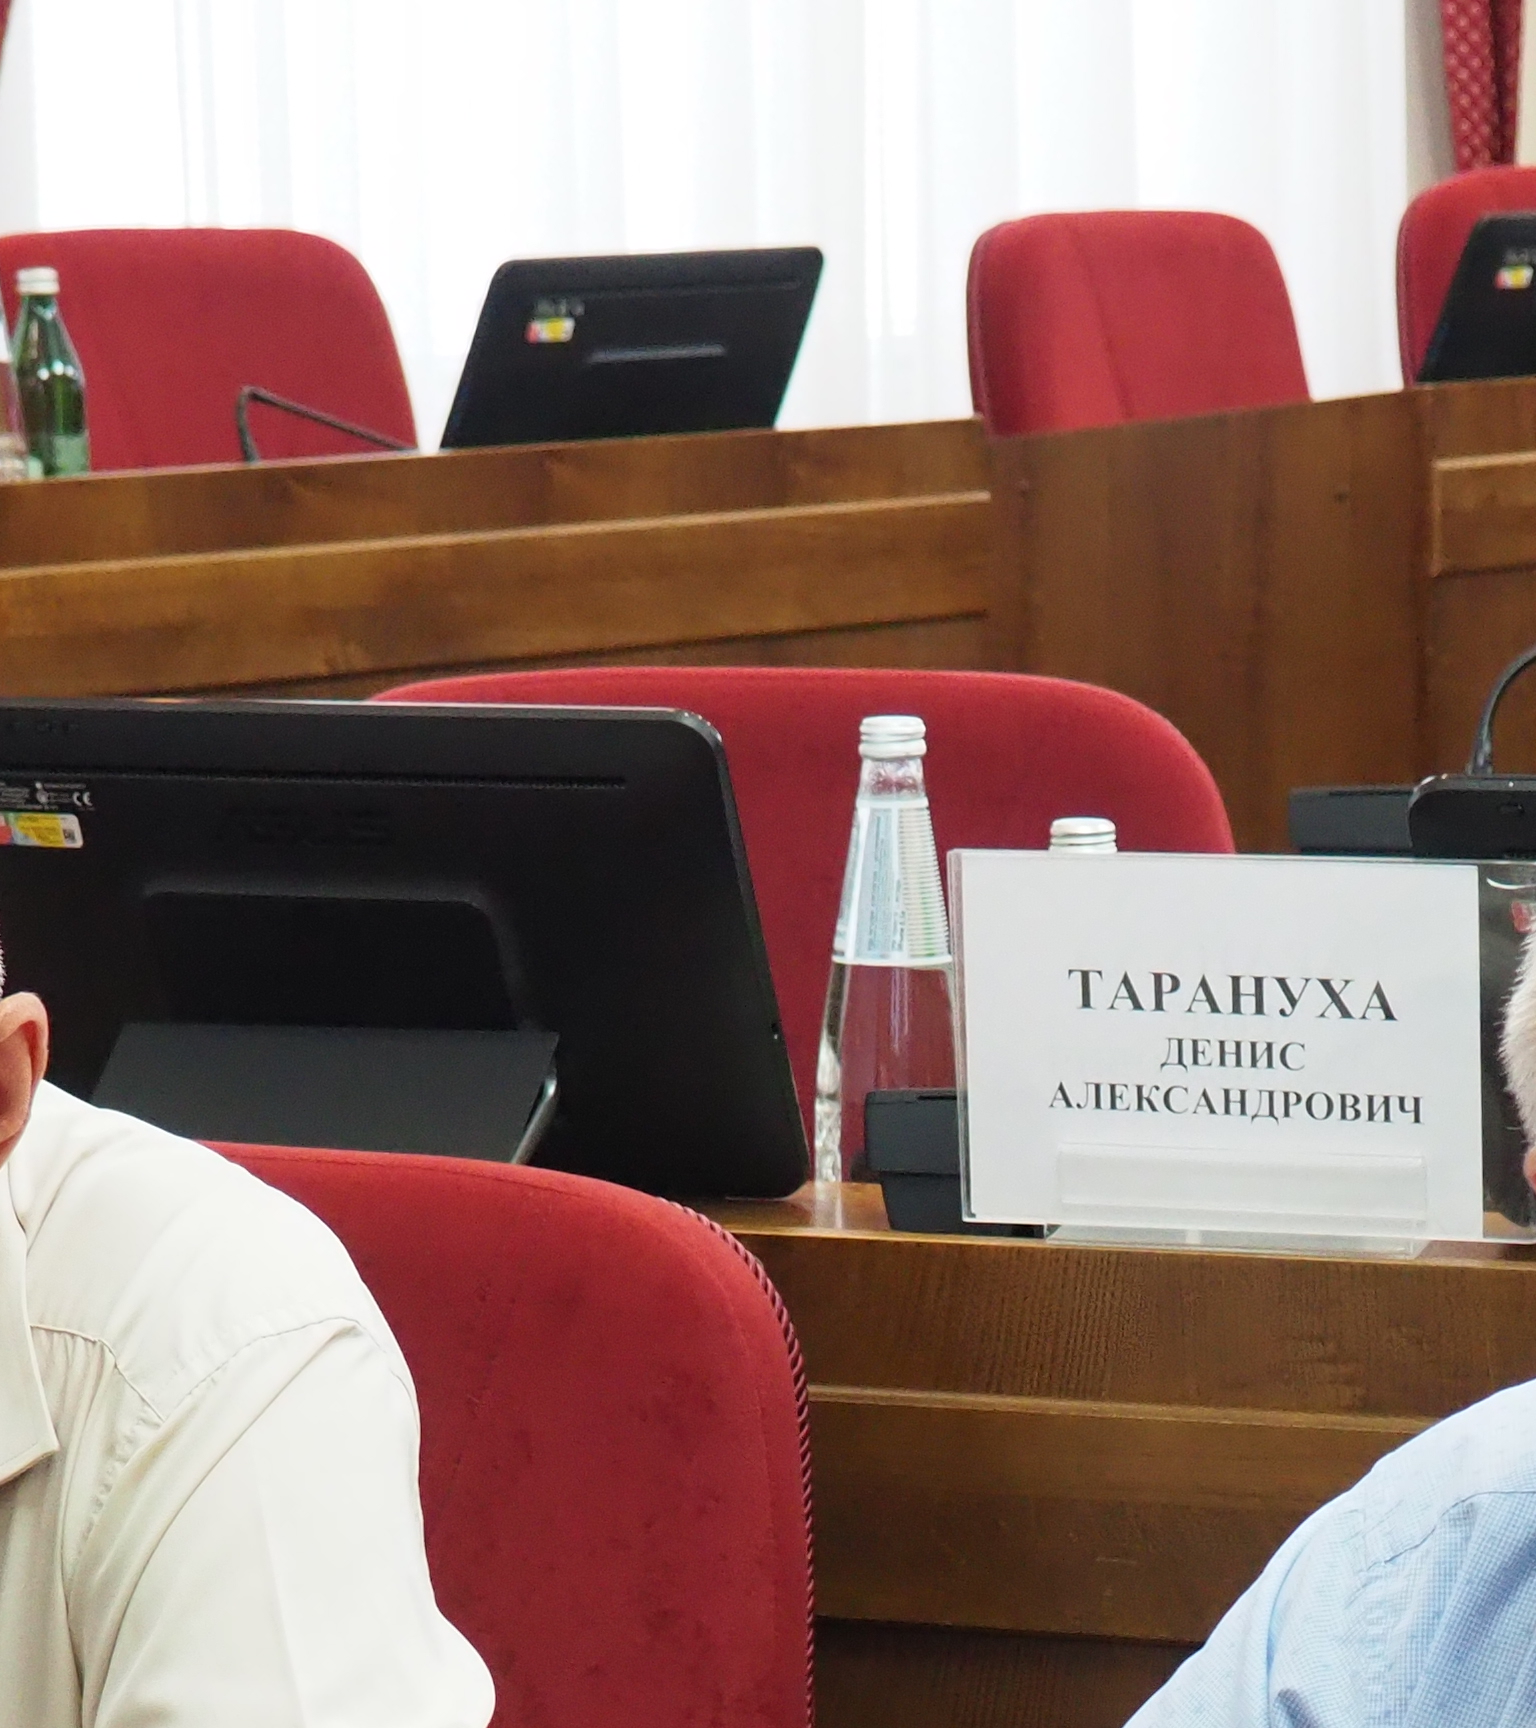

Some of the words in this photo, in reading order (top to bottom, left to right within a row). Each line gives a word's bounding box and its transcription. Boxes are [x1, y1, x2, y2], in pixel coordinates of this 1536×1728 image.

[1067, 968, 1399, 1022] ТАРАНУХА
[1160, 1037, 1307, 1072] ДЕНИС
[1049, 1081, 1423, 1125] АЛЕКСАНДРОВИЧ
